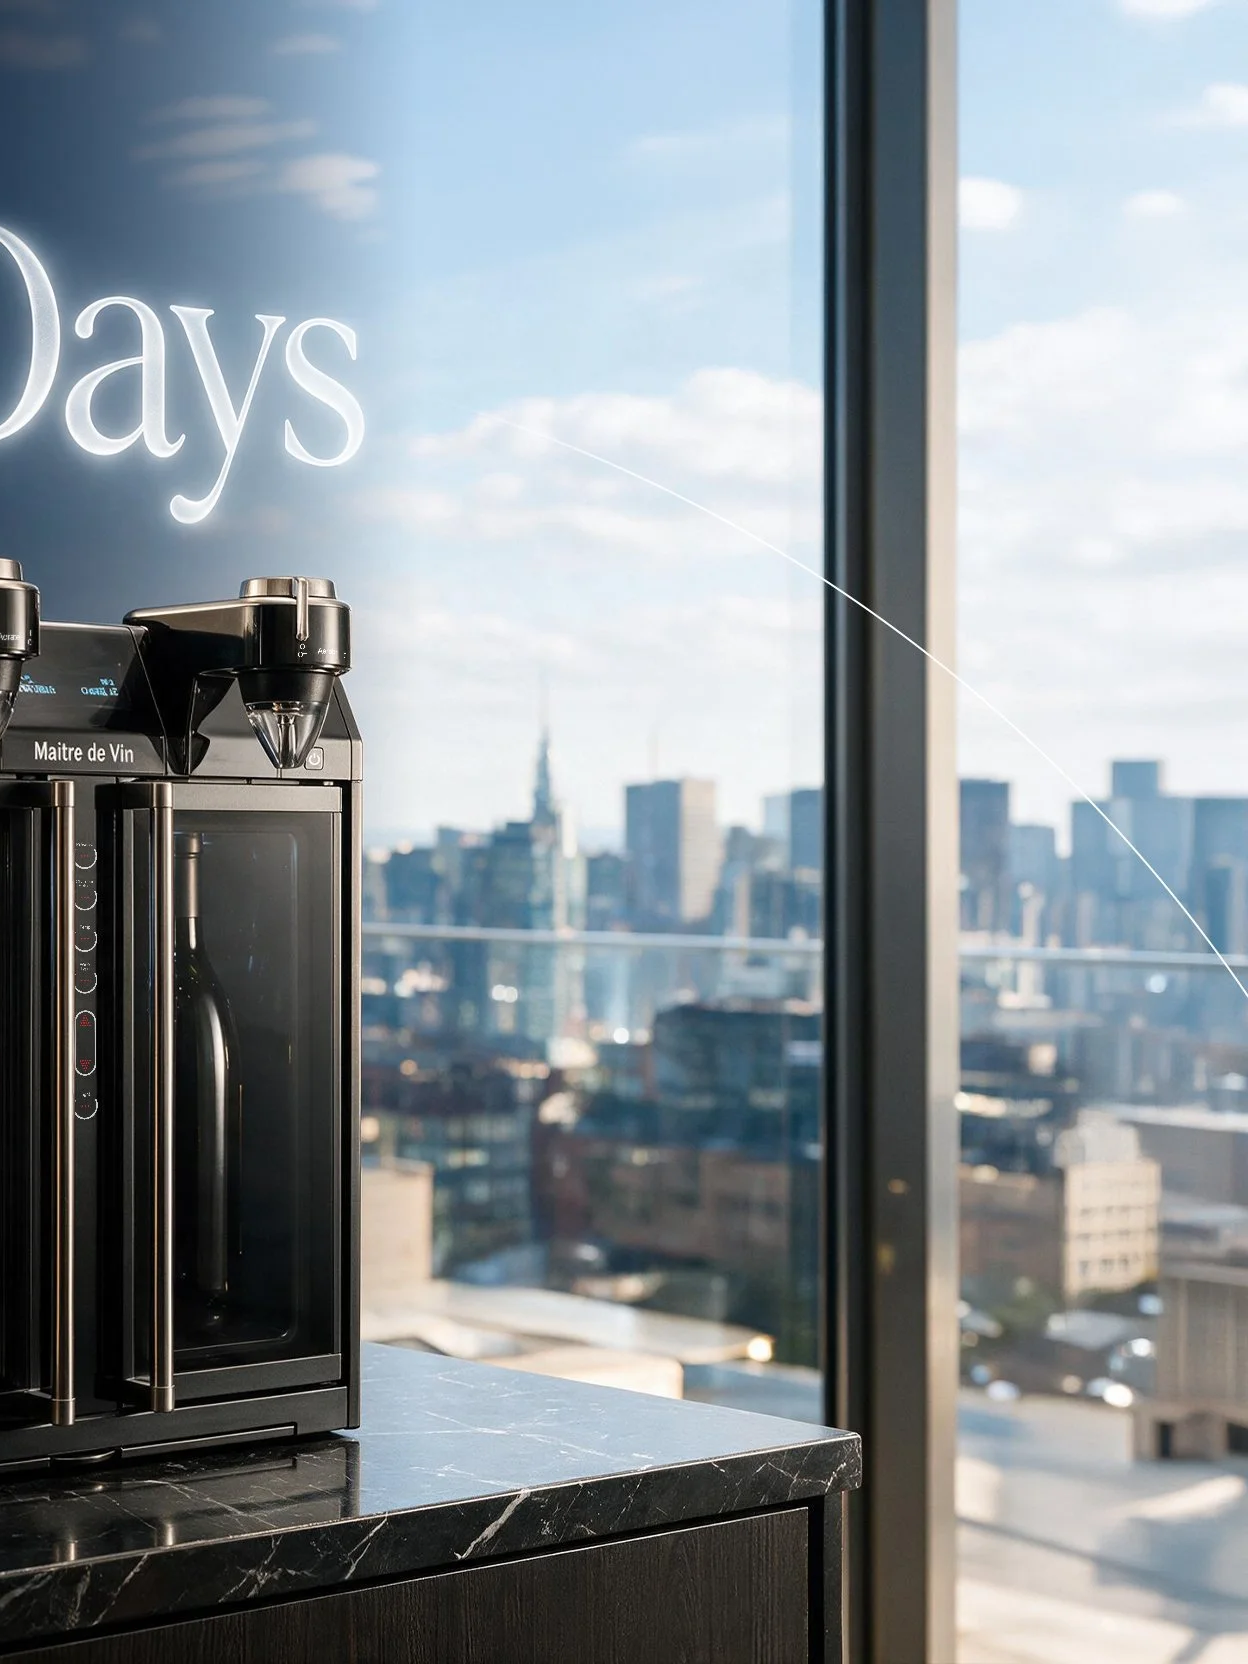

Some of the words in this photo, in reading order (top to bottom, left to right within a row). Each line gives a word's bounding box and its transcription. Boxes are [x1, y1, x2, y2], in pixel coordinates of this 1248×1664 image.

[34, 741, 84, 762] Maitre
[87, 742, 106, 763] de
[108, 743, 134, 764] Vin
